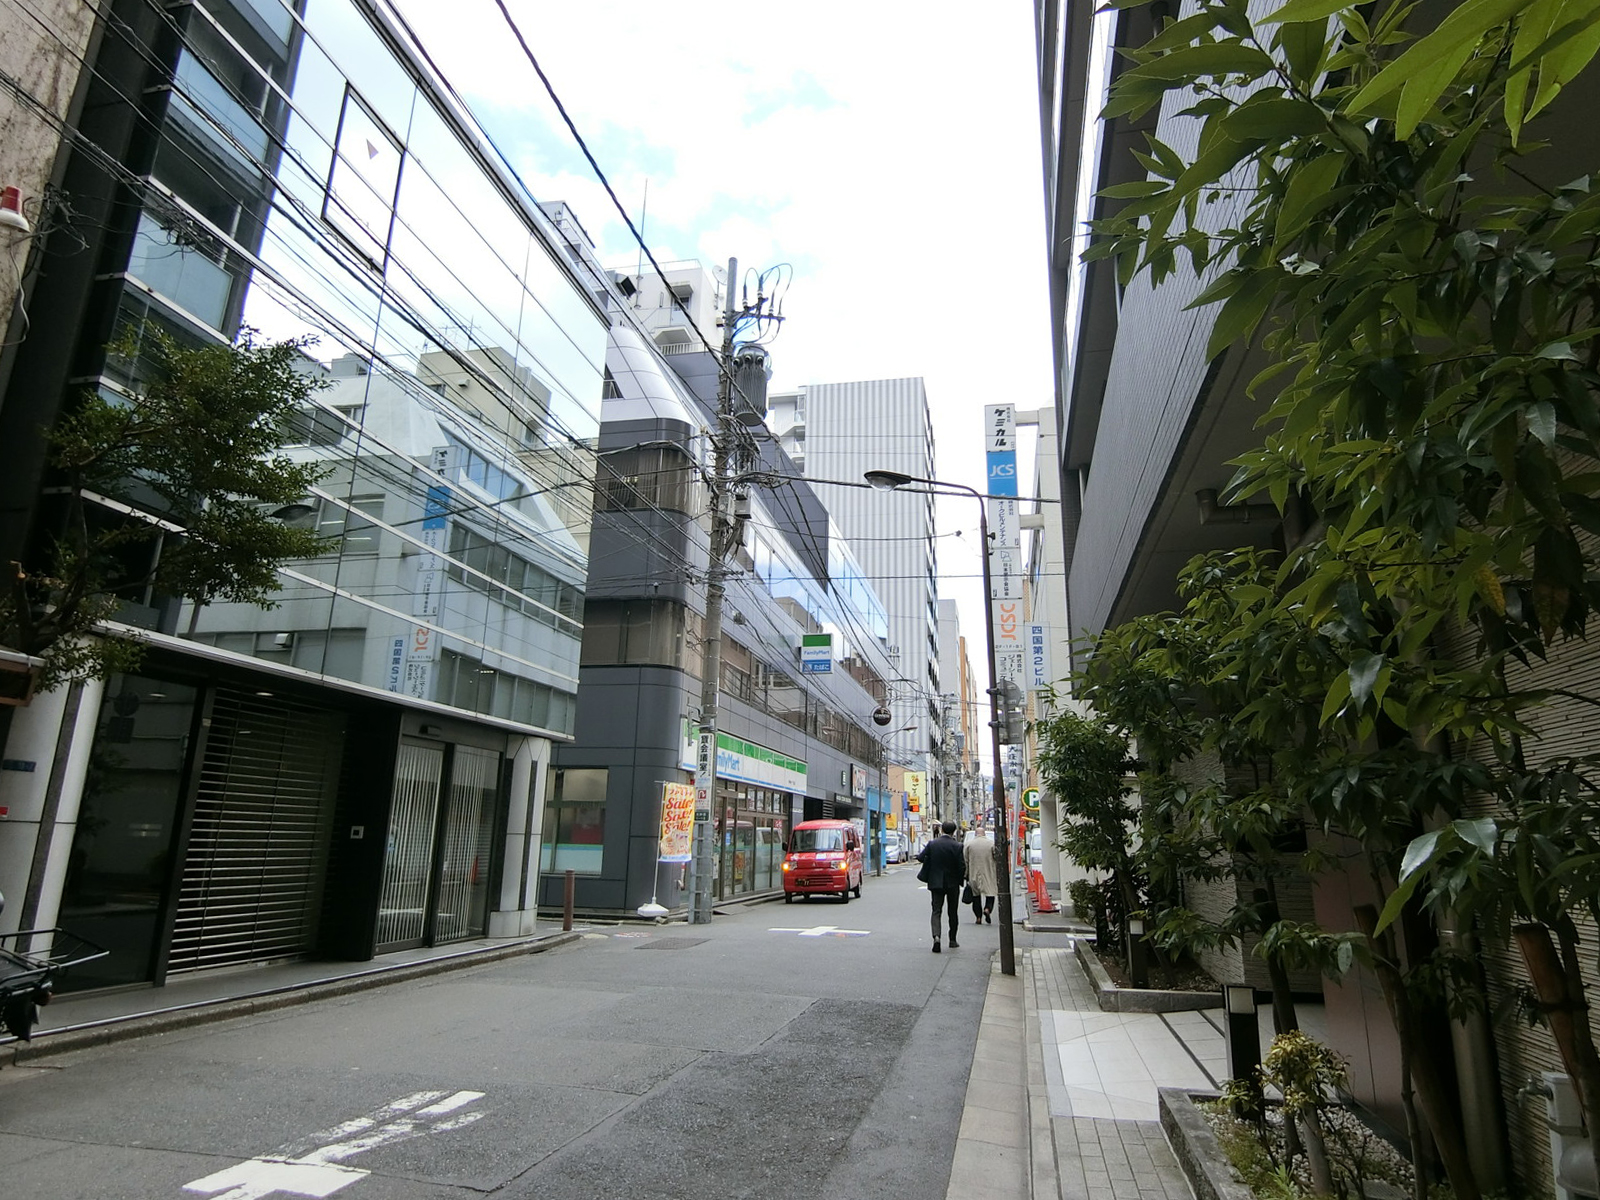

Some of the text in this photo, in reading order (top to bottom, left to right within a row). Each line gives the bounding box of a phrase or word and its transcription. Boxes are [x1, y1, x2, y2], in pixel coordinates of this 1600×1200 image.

[994, 408, 1007, 447] ケミカル
[989, 463, 1015, 477] JCS
[1000, 603, 1017, 641] JCSC
[1031, 625, 1046, 686] 四国第2ビル
[1028, 791, 1040, 807] P
